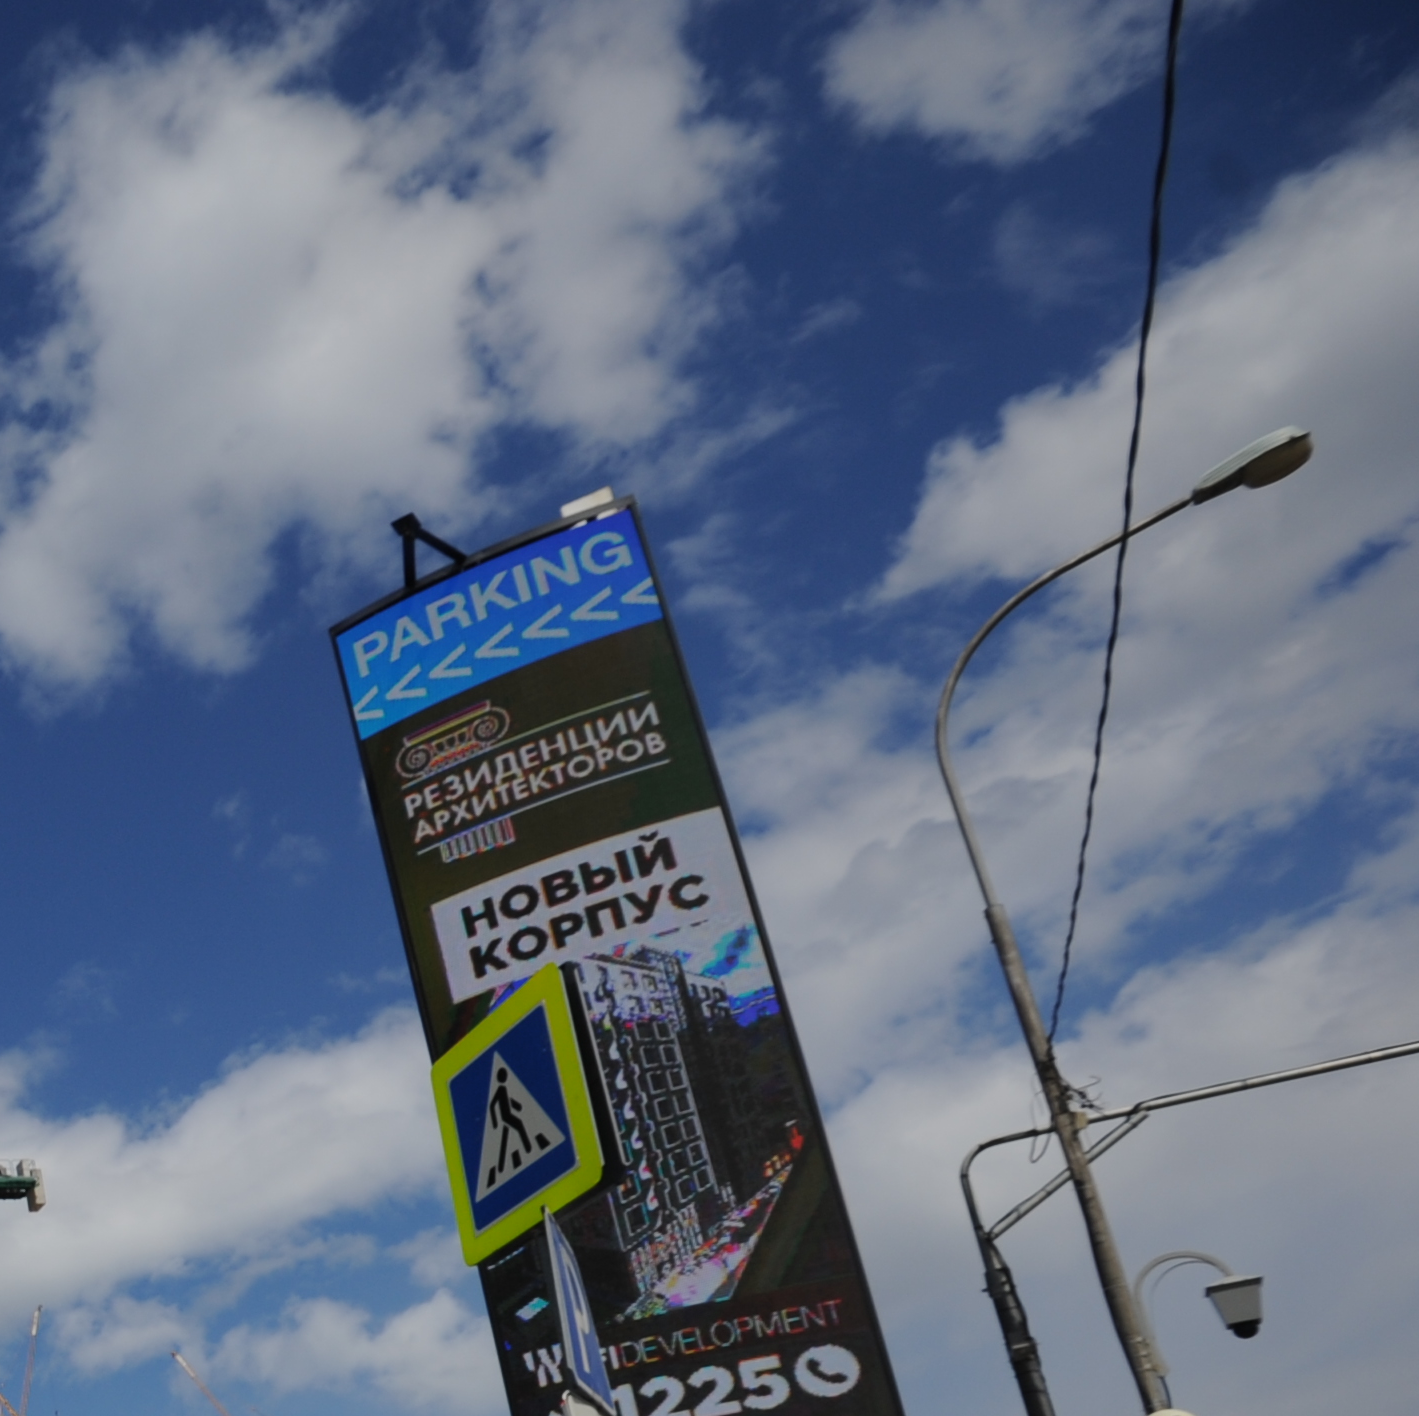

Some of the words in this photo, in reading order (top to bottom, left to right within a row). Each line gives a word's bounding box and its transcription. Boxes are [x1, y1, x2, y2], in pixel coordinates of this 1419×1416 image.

[352, 532, 633, 677] PARKING
[405, 701, 660, 818] РЕЗИДЕНЦИИ
[413, 730, 666, 844] АРХИТЕКТОРОВ
[461, 830, 677, 939] НОВЫЙ
[470, 874, 710, 980] КОРПУС
